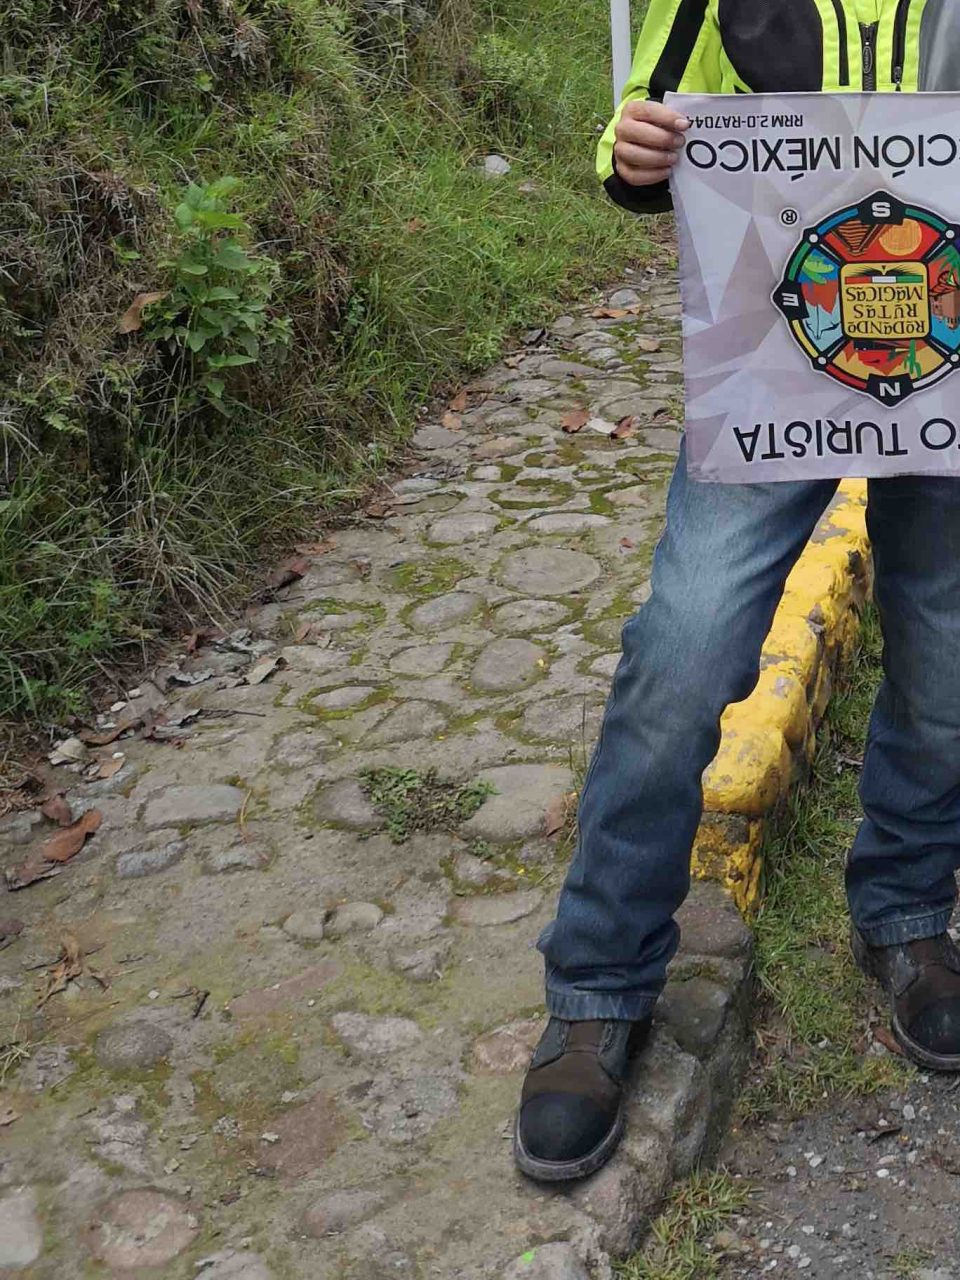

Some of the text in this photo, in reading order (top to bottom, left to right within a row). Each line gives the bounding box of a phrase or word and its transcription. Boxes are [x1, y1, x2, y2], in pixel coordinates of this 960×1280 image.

[771, 114, 804, 128] RRM
[686, 137, 841, 182] MÉXICO
[871, 201, 891, 217] S
[879, 382, 901, 397] N
[733, 419, 907, 462] TURISTA
